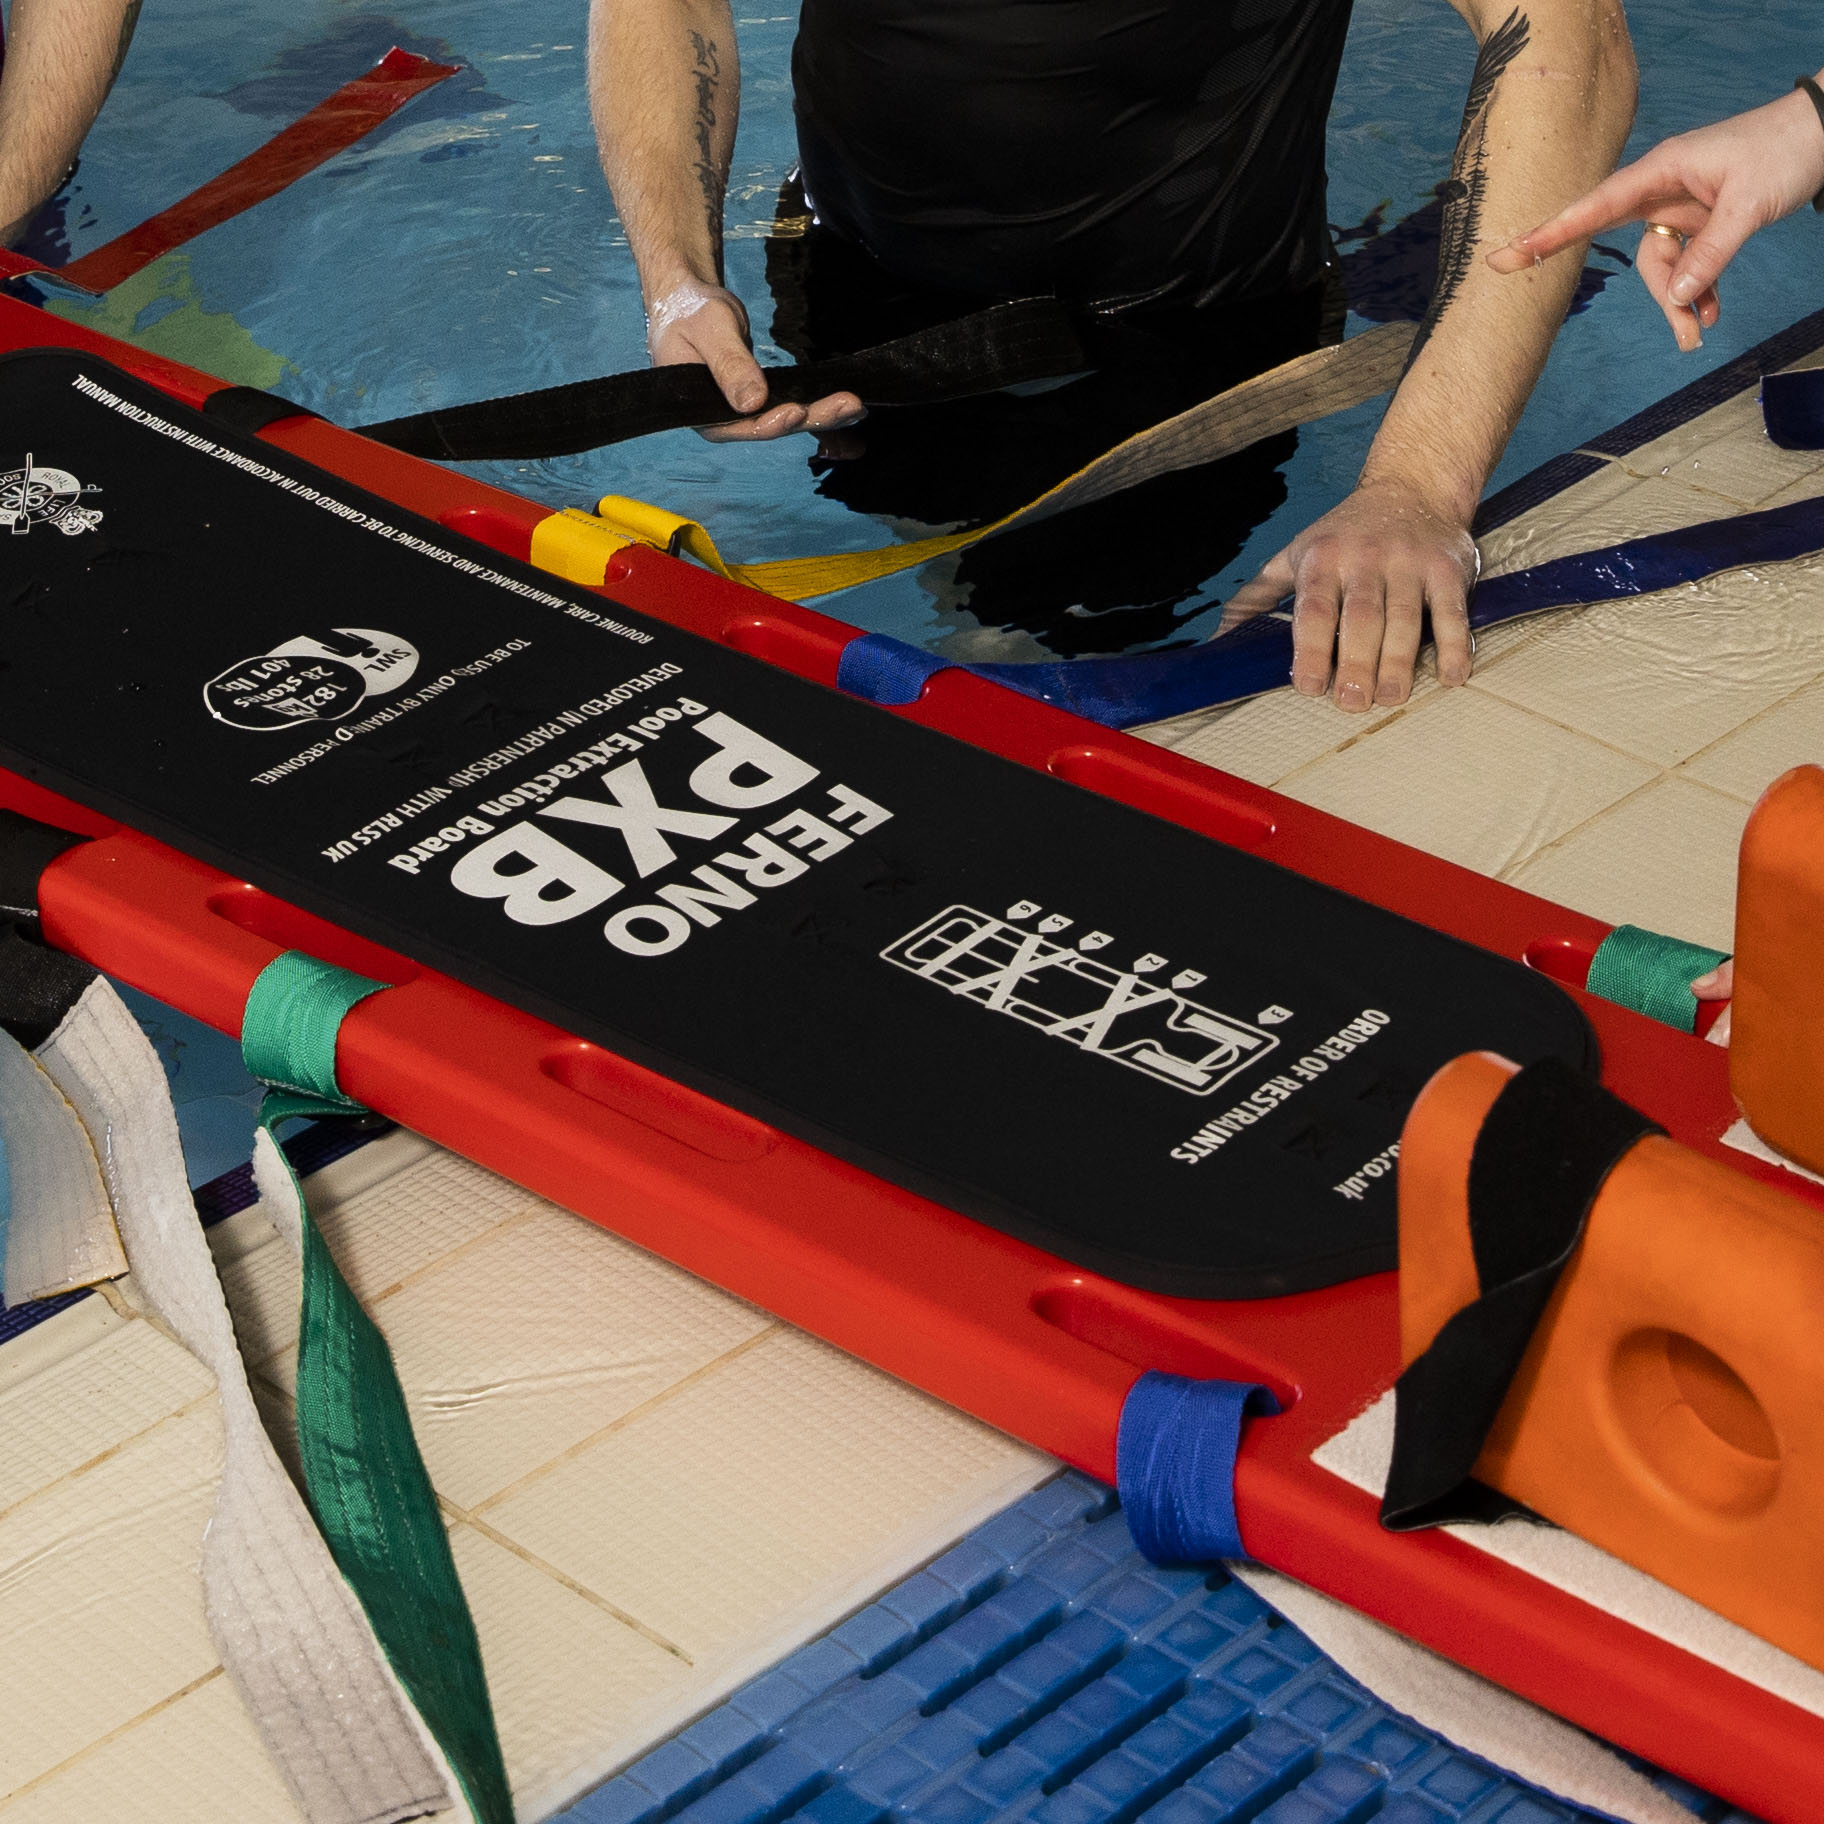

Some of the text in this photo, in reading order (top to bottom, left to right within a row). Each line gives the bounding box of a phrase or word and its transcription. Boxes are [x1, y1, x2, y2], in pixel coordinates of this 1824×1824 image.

[37, 499, 65, 516] LIFE
[72, 374, 654, 644] ROUTINE CARE, MAINTENANCE AND SERVICING TO BE CARRIED OUT IN ACCORDANCE WITH INSTRUCTION MANUAL
[485, 649, 512, 662] BE
[506, 639, 531, 650] TO
[364, 648, 411, 673] SWL
[215, 659, 292, 692] 401 lbs
[233, 666, 334, 708] 28 stones
[302, 683, 348, 706] 182
[416, 676, 455, 701] ONLY
[580, 663, 683, 715] DEVELOPED
[396, 698, 422, 711] BY
[556, 711, 588, 727] IN
[251, 739, 340, 784] PERSONNEL
[387, 697, 708, 874] Pool Extraction Board
[396, 787, 452, 817] WITH
[352, 813, 403, 845] RLSS
[450, 711, 822, 926] PXB
[321, 841, 358, 863] UK
[604, 784, 894, 956] FERNO
[1019, 903, 1031, 913] 6
[1051, 917, 1064, 927] 5
[1092, 934, 1104, 945] 4
[1148, 956, 1160, 966] 2
[1184, 973, 1198, 983] 1
[1272, 1008, 1285, 1018] 3
[1170, 1010, 1390, 1164] ORDER OF RESTRAINTS
[1333, 1140, 1401, 1201] o.co.uk
